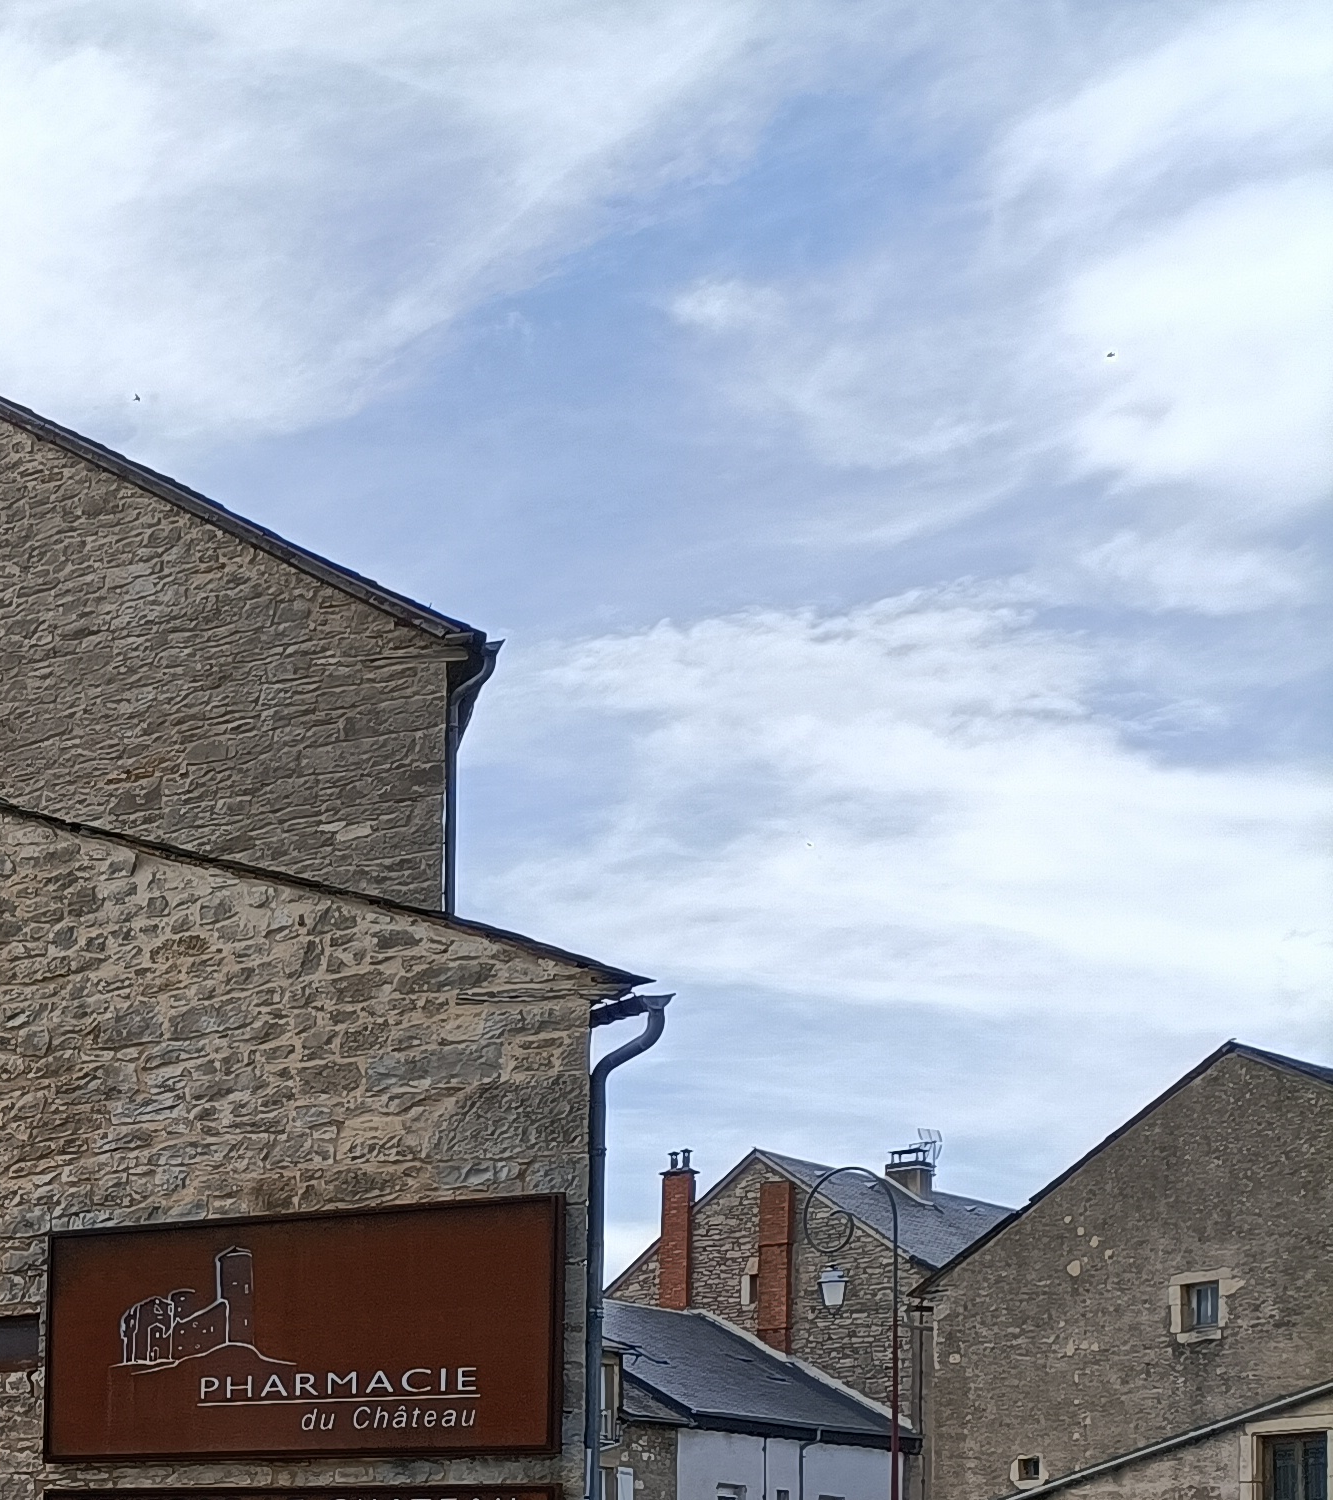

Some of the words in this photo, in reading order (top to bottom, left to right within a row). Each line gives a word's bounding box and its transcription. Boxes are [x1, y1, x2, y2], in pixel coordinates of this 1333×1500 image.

[200, 1366, 478, 1400] PHARMACIE
[301, 1408, 335, 1431] du
[352, 1405, 477, 1430] Château
